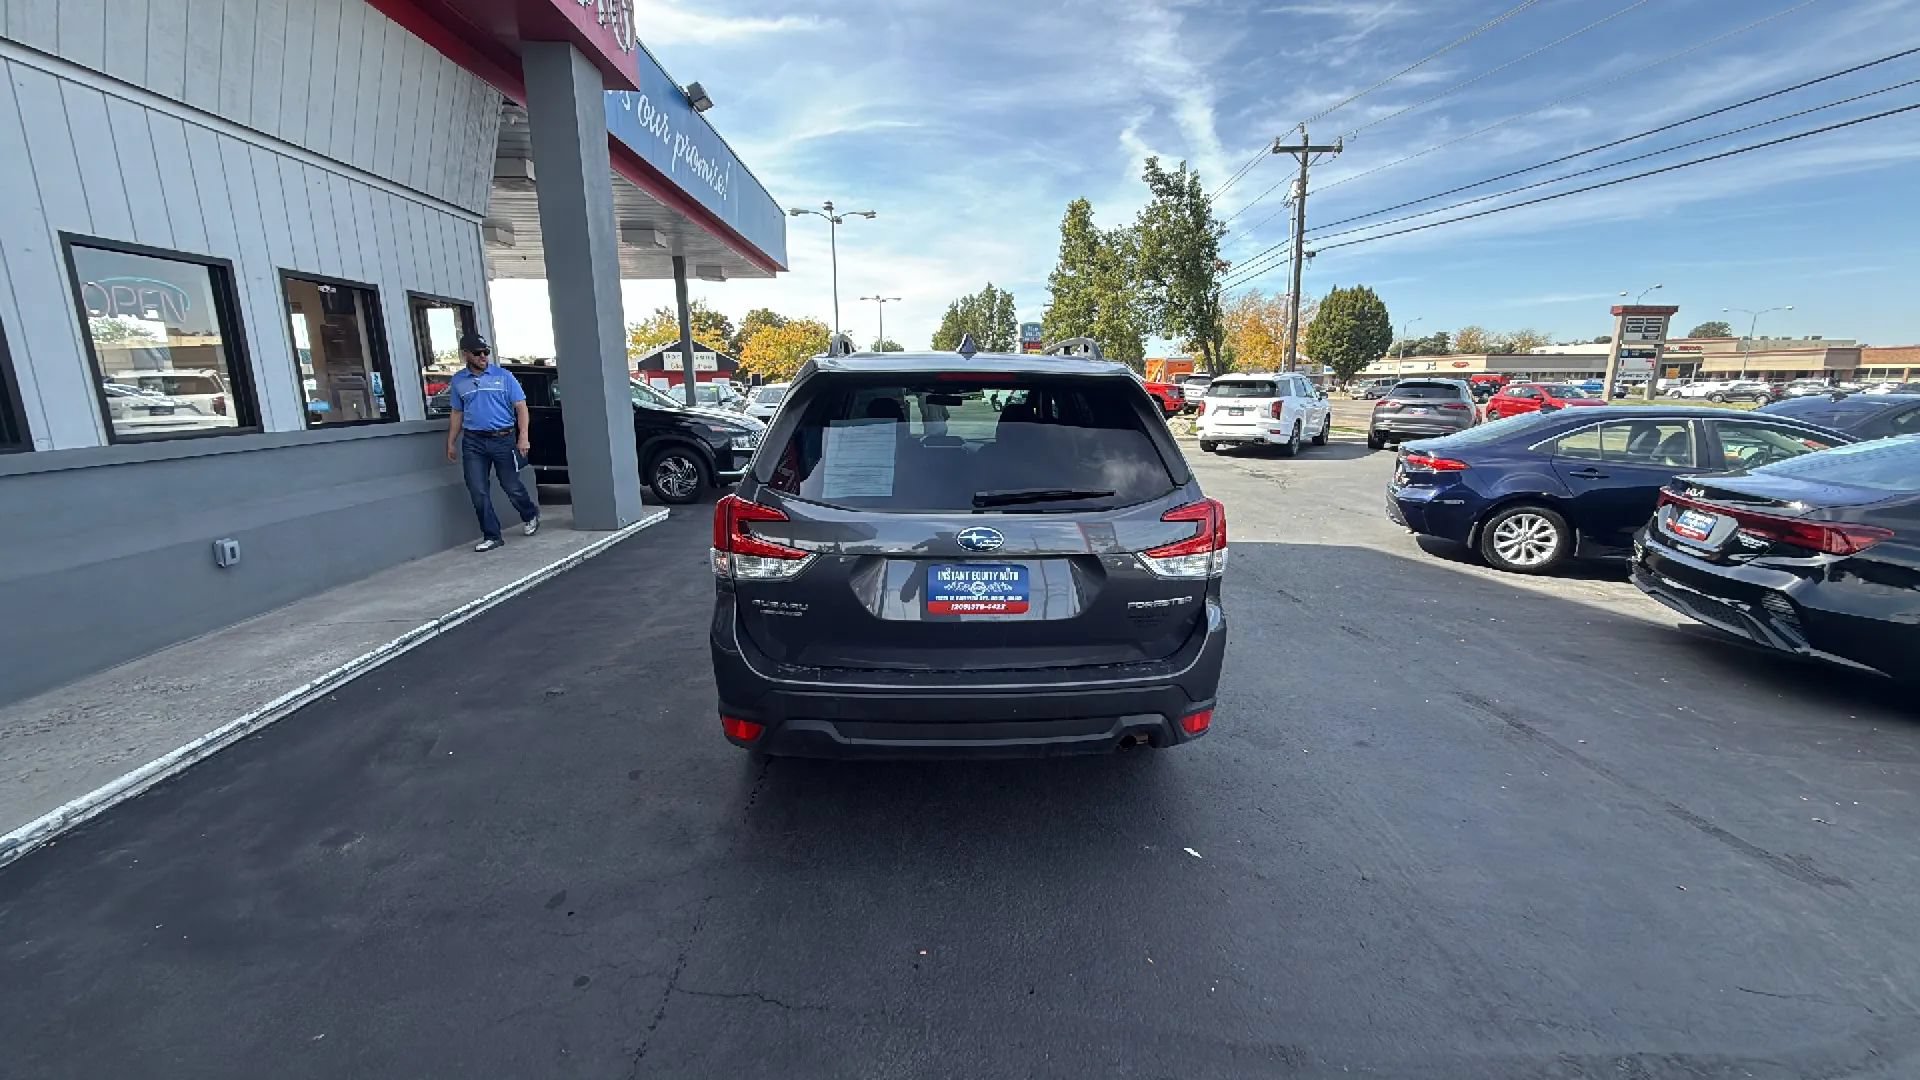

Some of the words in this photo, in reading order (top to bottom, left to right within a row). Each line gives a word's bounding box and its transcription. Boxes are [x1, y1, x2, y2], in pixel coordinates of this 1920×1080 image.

[637, 94, 671, 144] our
[671, 130, 731, 200] promise!
[81, 281, 186, 323] OPEN
[937, 570, 970, 581] INSTANT
[971, 571, 999, 581] EQUITY
[1127, 595, 1193, 609] FORESTER
